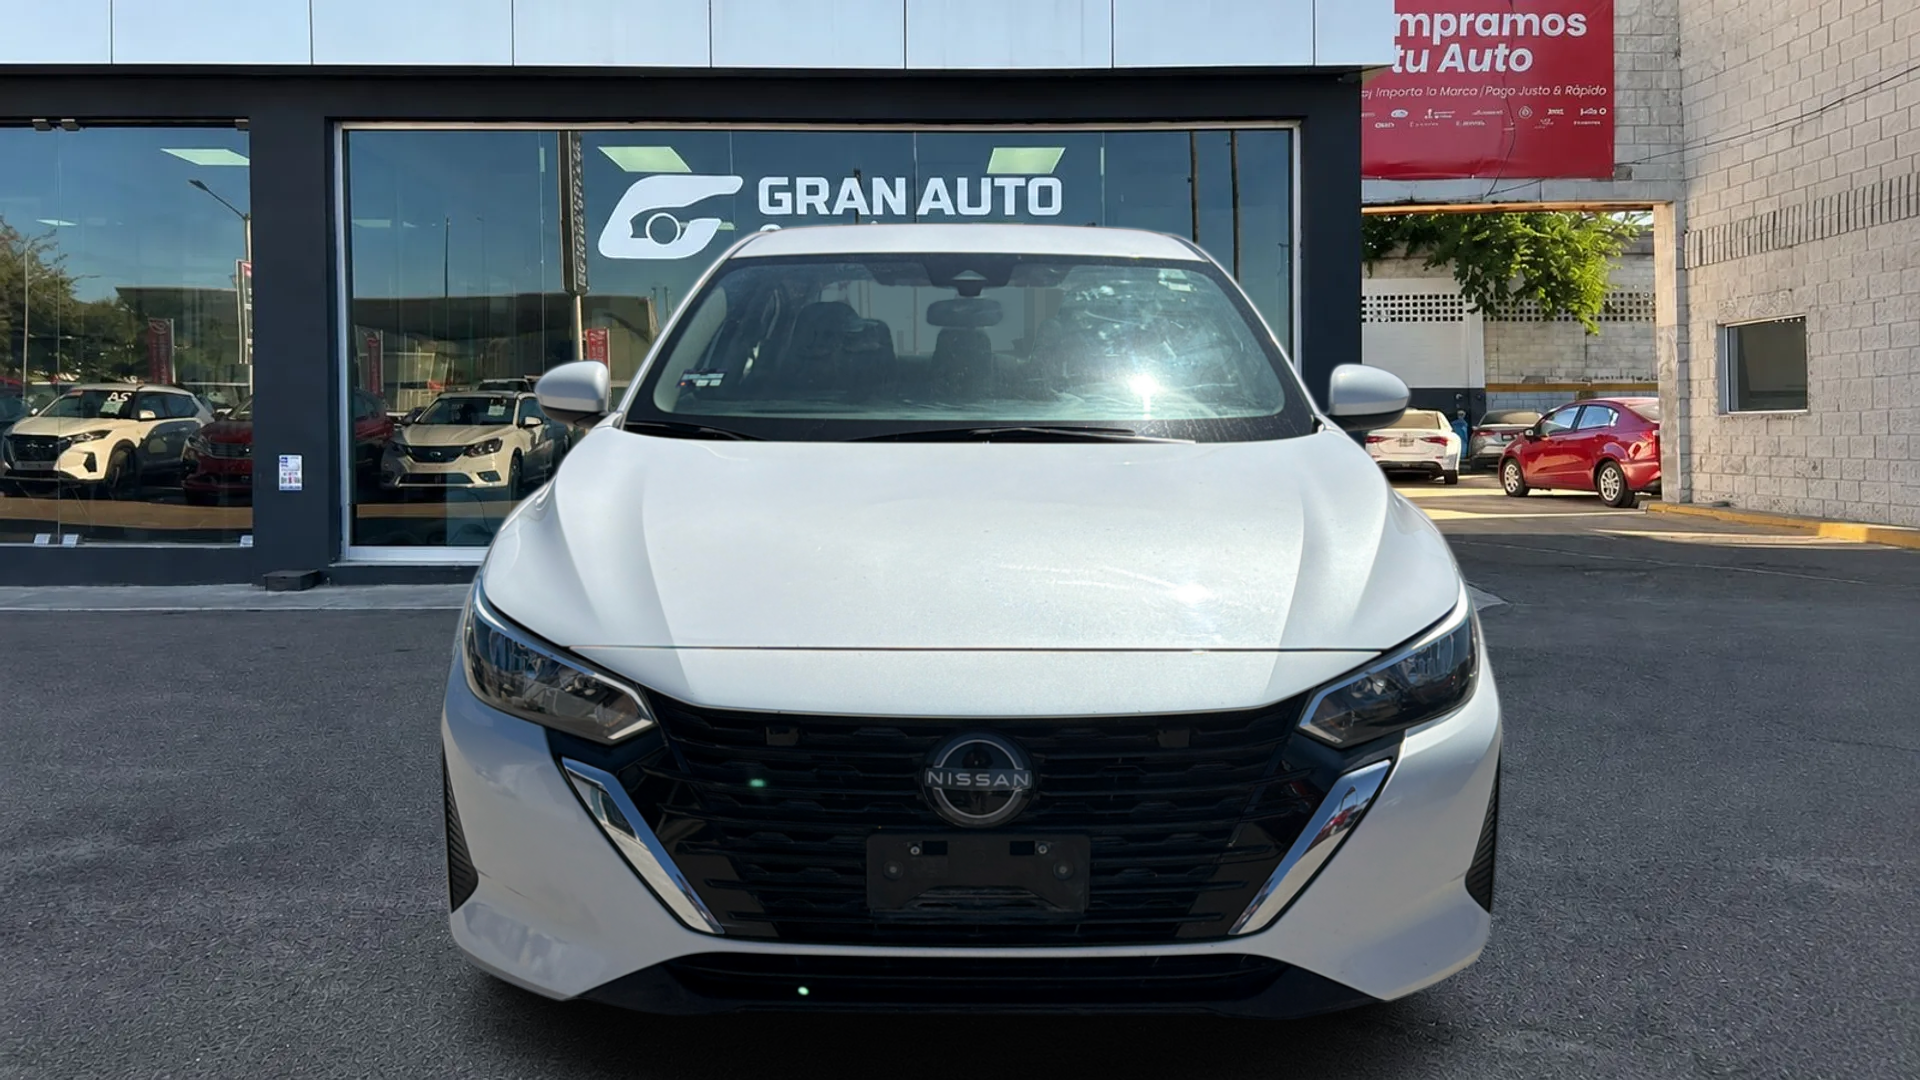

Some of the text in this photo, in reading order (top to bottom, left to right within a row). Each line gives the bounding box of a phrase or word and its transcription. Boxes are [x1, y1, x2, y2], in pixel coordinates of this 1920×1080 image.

[1395, 13, 1587, 45] mpramos
[1392, 43, 1533, 72] tu Auto
[1375, 87, 1423, 100] Importa
[1439, 86, 1478, 97] Marca
[1518, 86, 1551, 96] Justo
[1553, 86, 1562, 96] &
[1564, 84, 1607, 98] Rápido
[758, 176, 1063, 217] GRAN AUTO
[928, 771, 1029, 787] NISSAN
